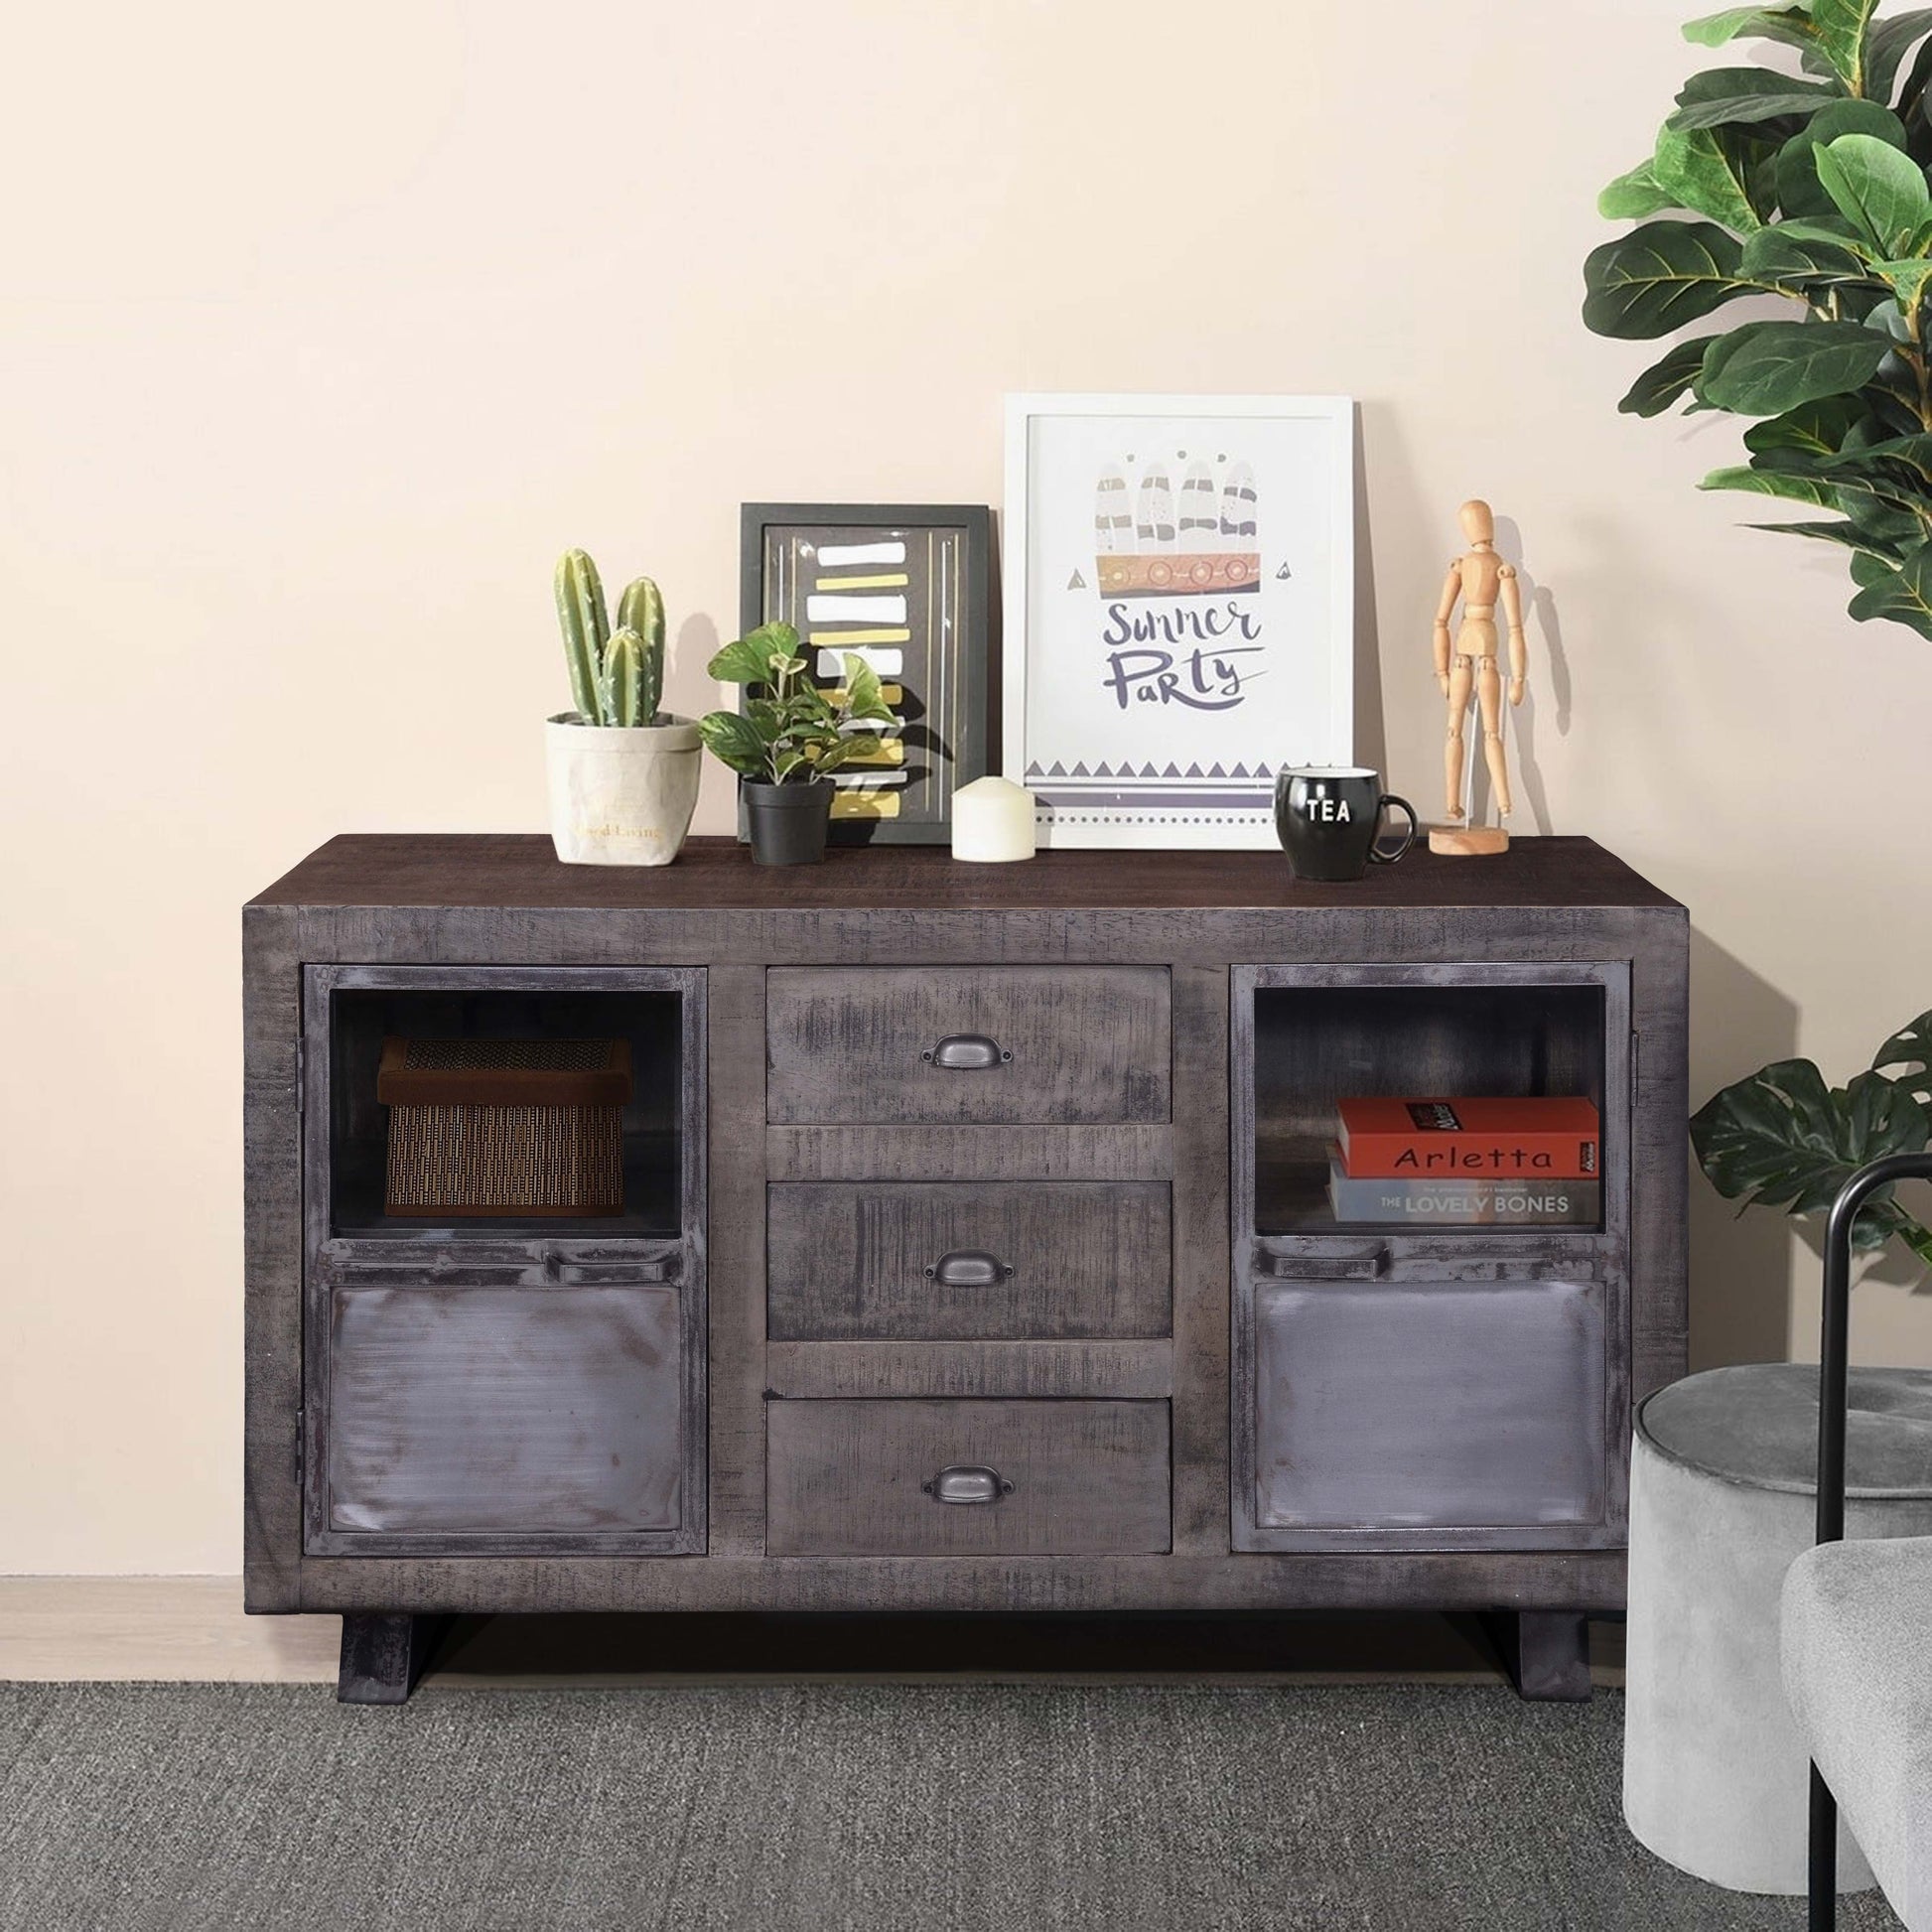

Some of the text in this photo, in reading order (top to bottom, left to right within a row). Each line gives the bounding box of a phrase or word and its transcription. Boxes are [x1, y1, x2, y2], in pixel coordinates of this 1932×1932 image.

[1103, 602, 1262, 645] Summer
[1307, 799, 1350, 822] TEA
[1394, 1147, 1552, 1169] Arletta
[1381, 1196, 1569, 1213] THE LOVELY BONES
